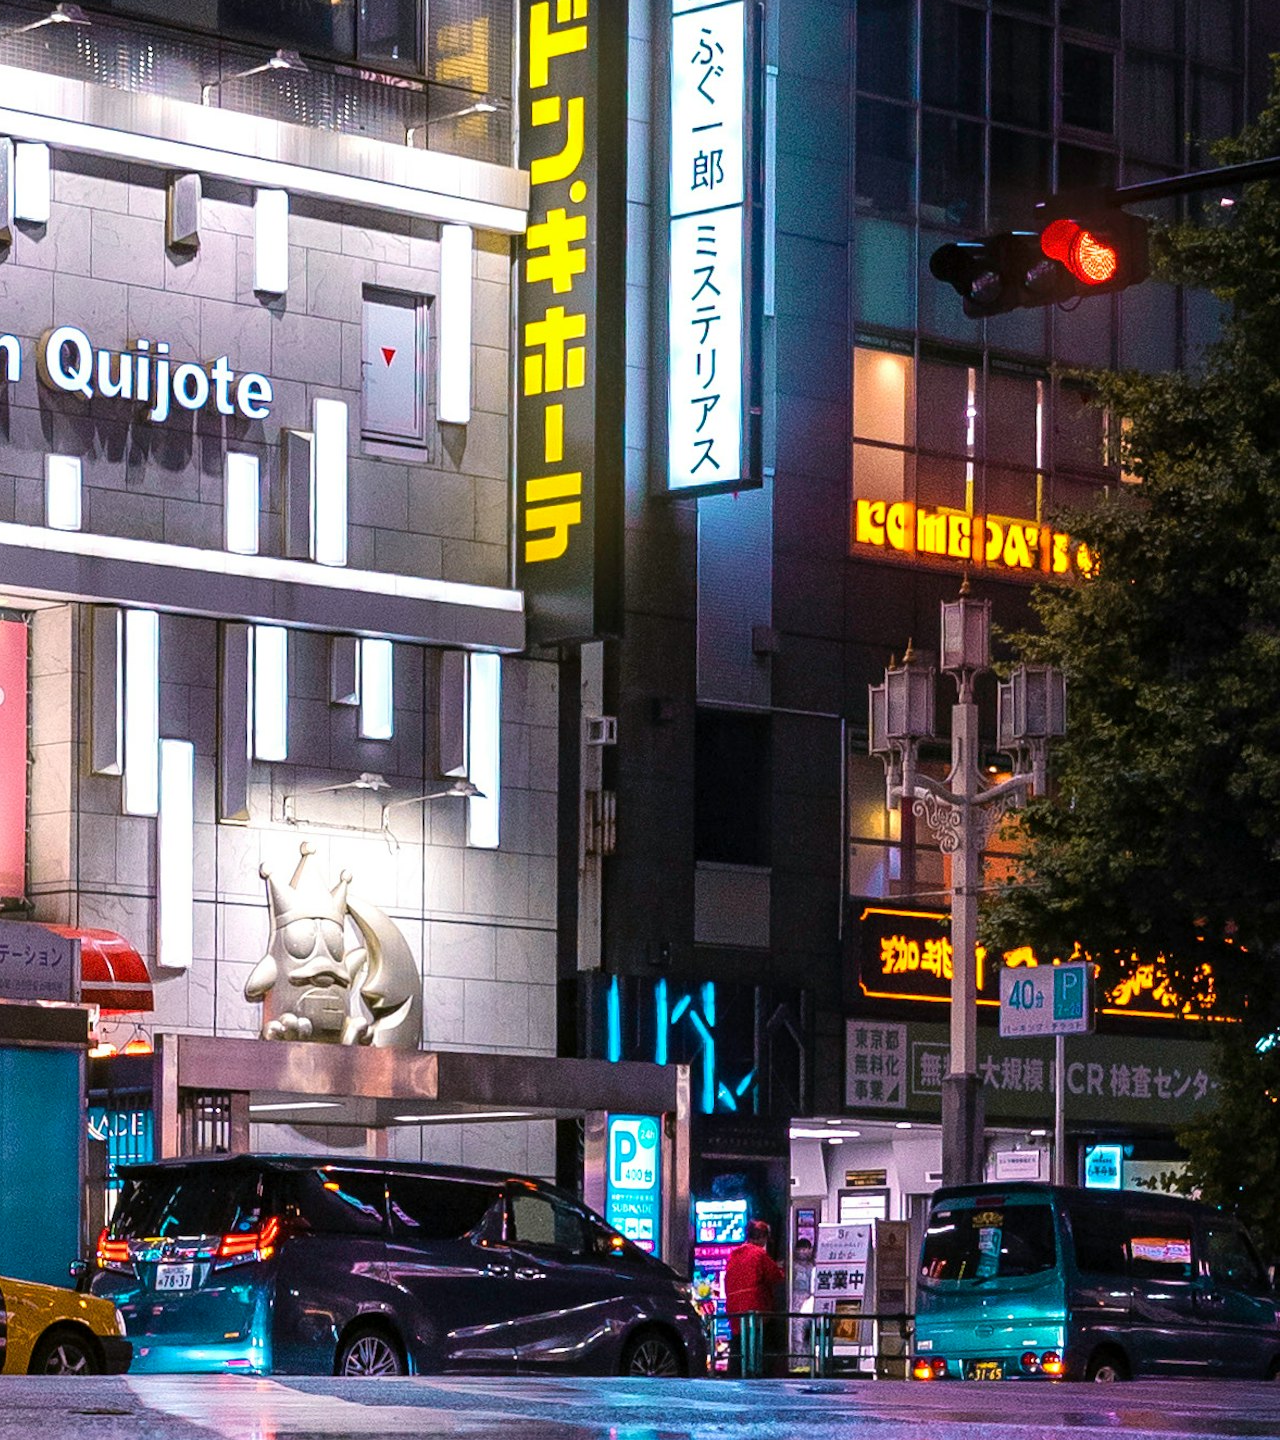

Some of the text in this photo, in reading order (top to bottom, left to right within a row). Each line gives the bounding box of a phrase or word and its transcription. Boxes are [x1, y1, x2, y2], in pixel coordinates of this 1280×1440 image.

[689, 27, 725, 193] ふぐ一郎
[689, 222, 722, 475] ミステリアス
[44, 324, 274, 423] Quijote
[1062, 971, 1078, 1002] P
[853, 1026, 900, 1051] 東京都
[853, 1052, 900, 1079] 無料化
[853, 1080, 885, 1103] 事業
[640, 1127, 656, 1141] 24h
[614, 1129, 637, 1182] P
[816, 1269, 865, 1292] 営業中
